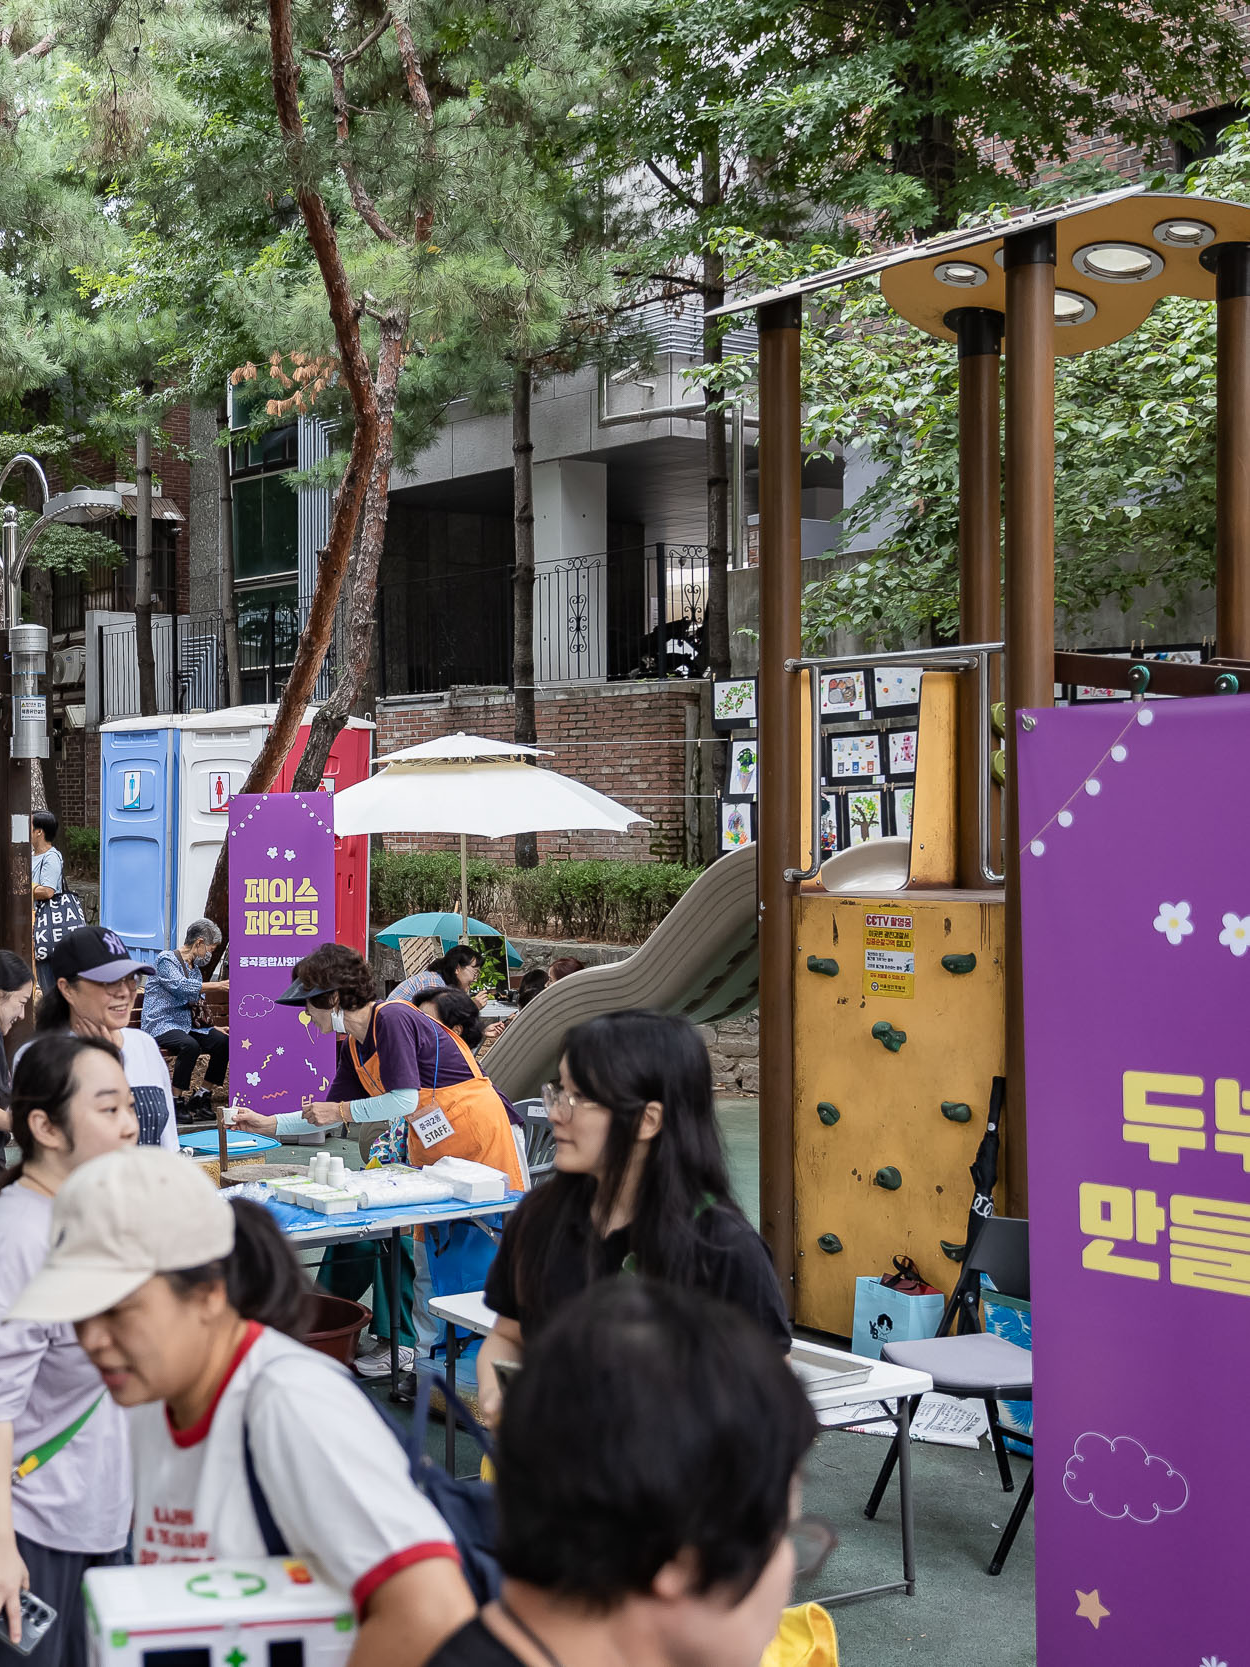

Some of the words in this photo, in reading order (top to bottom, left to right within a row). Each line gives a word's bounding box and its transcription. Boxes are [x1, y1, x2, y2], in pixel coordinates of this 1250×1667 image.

[244, 877, 319, 903] 페이스
[244, 909, 319, 936] 페인팅
[866, 915, 889, 926] CCTV
[419, 1114, 441, 1130] 중곡2동
[1078, 1181, 1250, 1297] 만들
